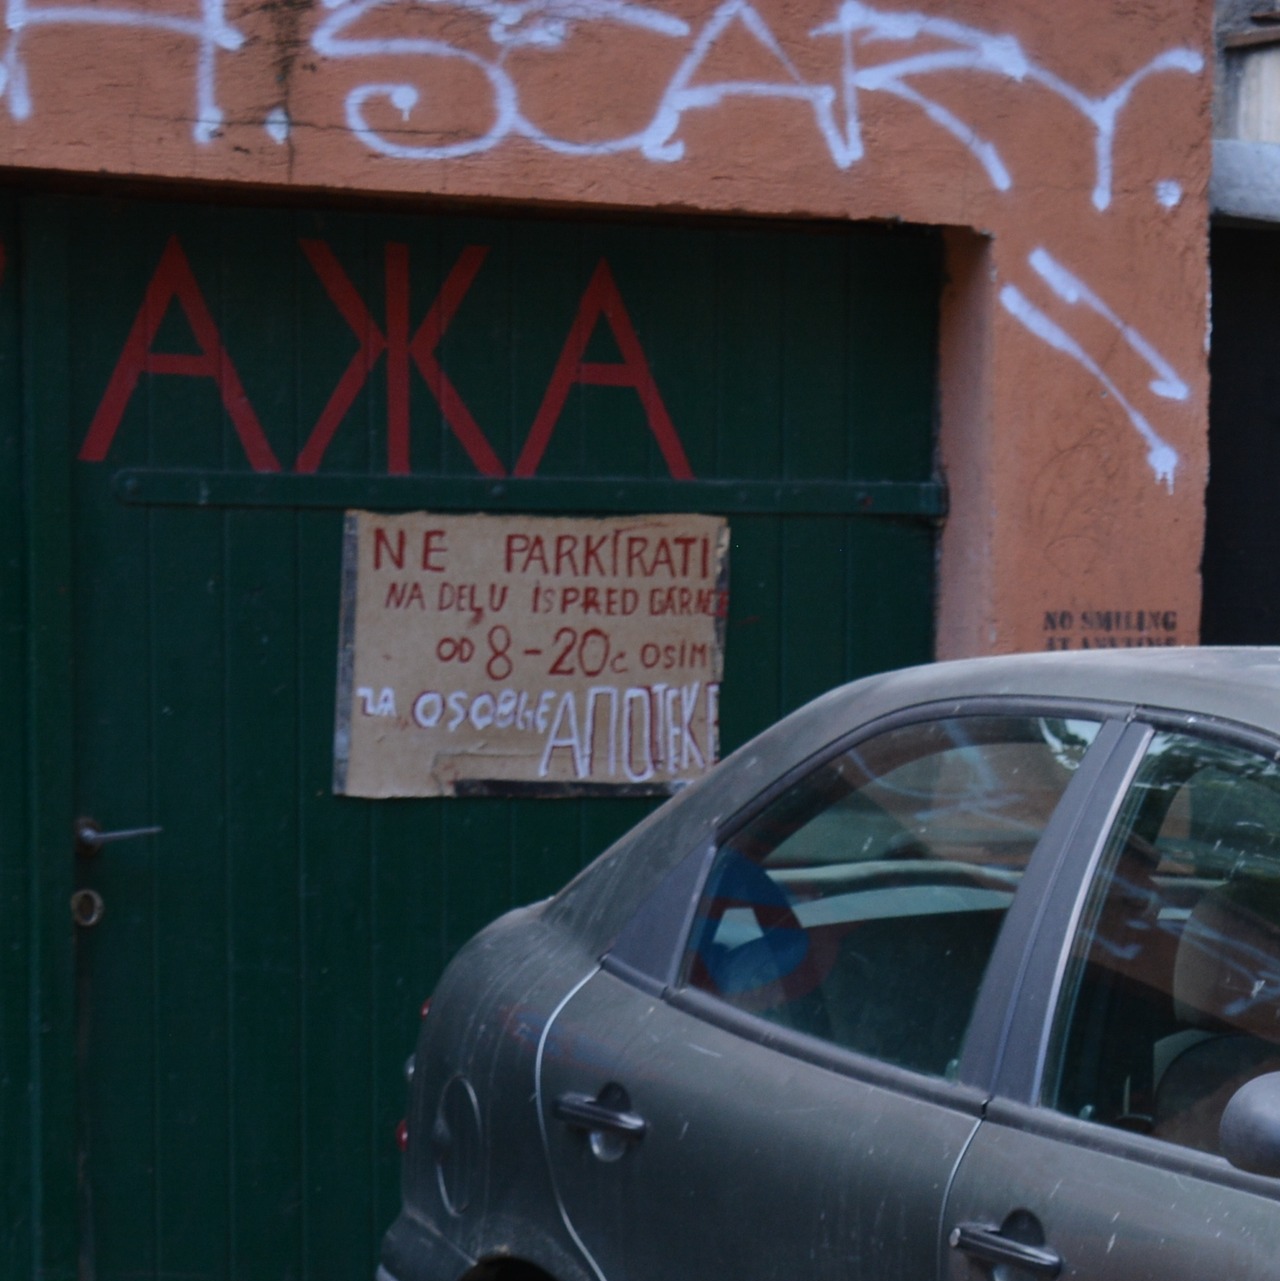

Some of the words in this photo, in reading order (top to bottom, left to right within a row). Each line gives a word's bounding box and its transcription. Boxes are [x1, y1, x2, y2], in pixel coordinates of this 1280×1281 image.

[0, 230, 695, 480] АЖА
[373, 527, 446, 572] NE
[504, 523, 711, 578] PARKIRATI
[385, 581, 426, 611] NA
[1043, 611, 1074, 632] NO
[1080, 610, 1178, 633] SMILING
[436, 636, 475, 664] OD
[640, 638, 709, 670] OSIM
